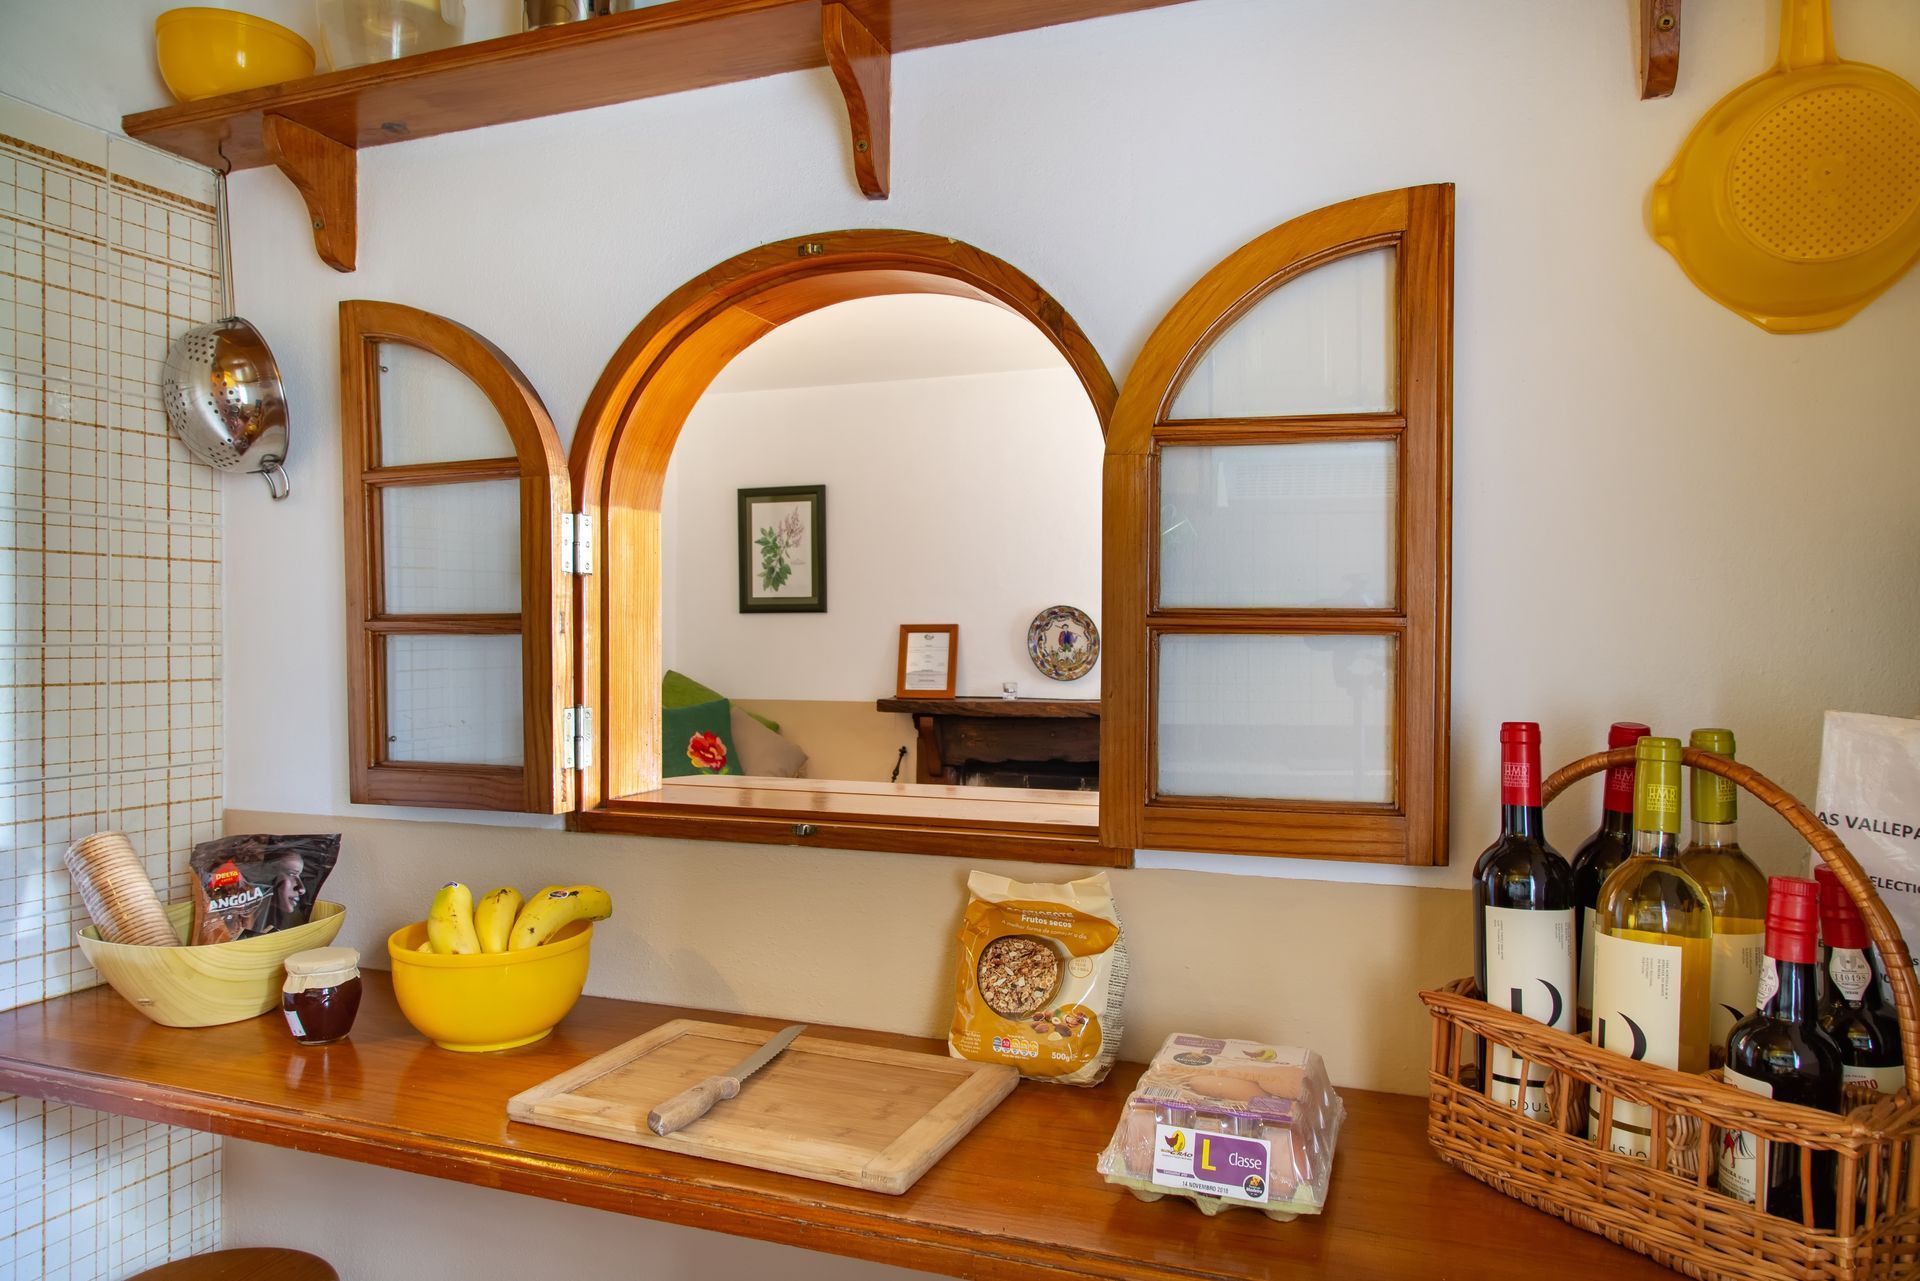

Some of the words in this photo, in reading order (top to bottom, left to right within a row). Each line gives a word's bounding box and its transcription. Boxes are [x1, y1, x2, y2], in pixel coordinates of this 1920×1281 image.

[215, 871, 239, 880] DELTA
[1869, 875, 1920, 894] ELECTI
[208, 887, 264, 909] ANGOLA
[1021, 914, 1048, 925] Frutos
[1049, 920, 1072, 928] secos
[1509, 1098, 1550, 1113] POUS
[1201, 1138, 1217, 1171] L
[1228, 1152, 1262, 1170] Classe
[1188, 1181, 1217, 1192] NOVEMBRO
